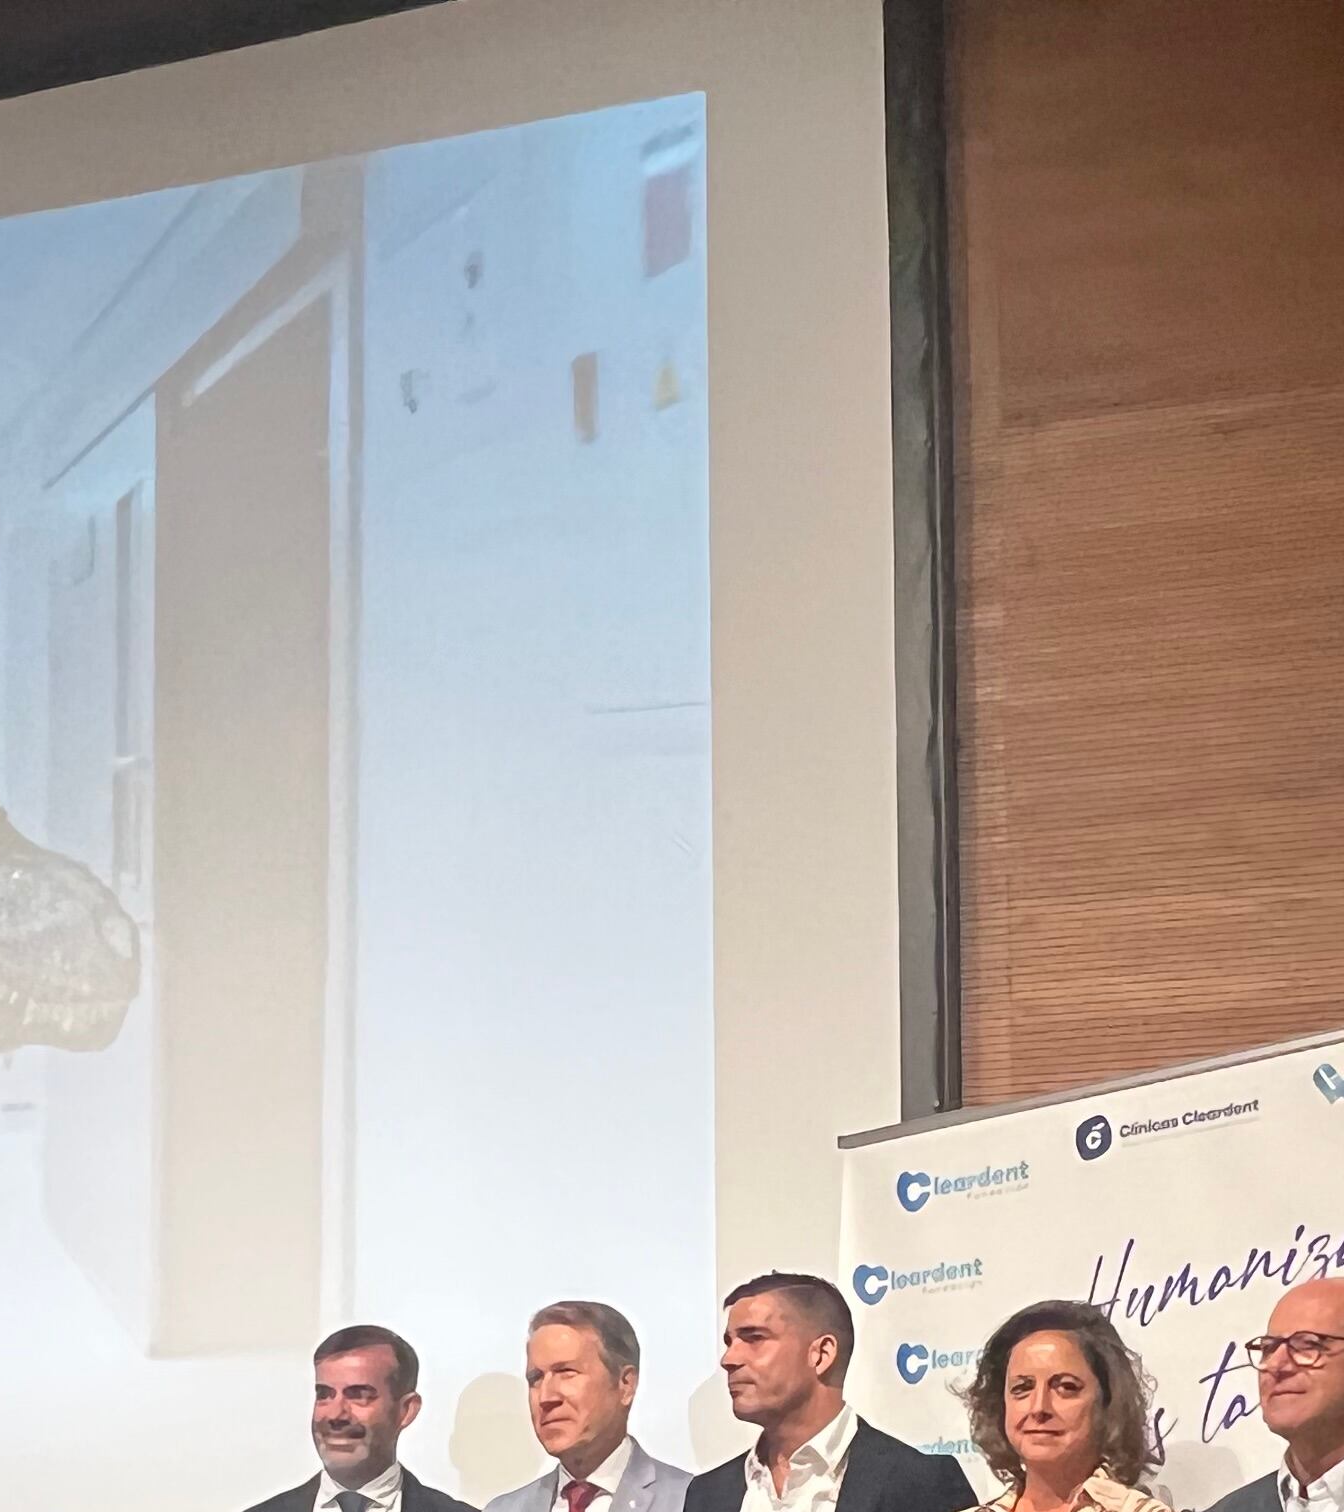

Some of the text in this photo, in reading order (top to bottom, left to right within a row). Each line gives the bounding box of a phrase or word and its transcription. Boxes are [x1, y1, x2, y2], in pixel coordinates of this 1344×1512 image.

[1182, 1099, 1260, 1126] Cleardent
[896, 1160, 1030, 1213] Cleardent
[852, 1258, 984, 1306] Cleardent
